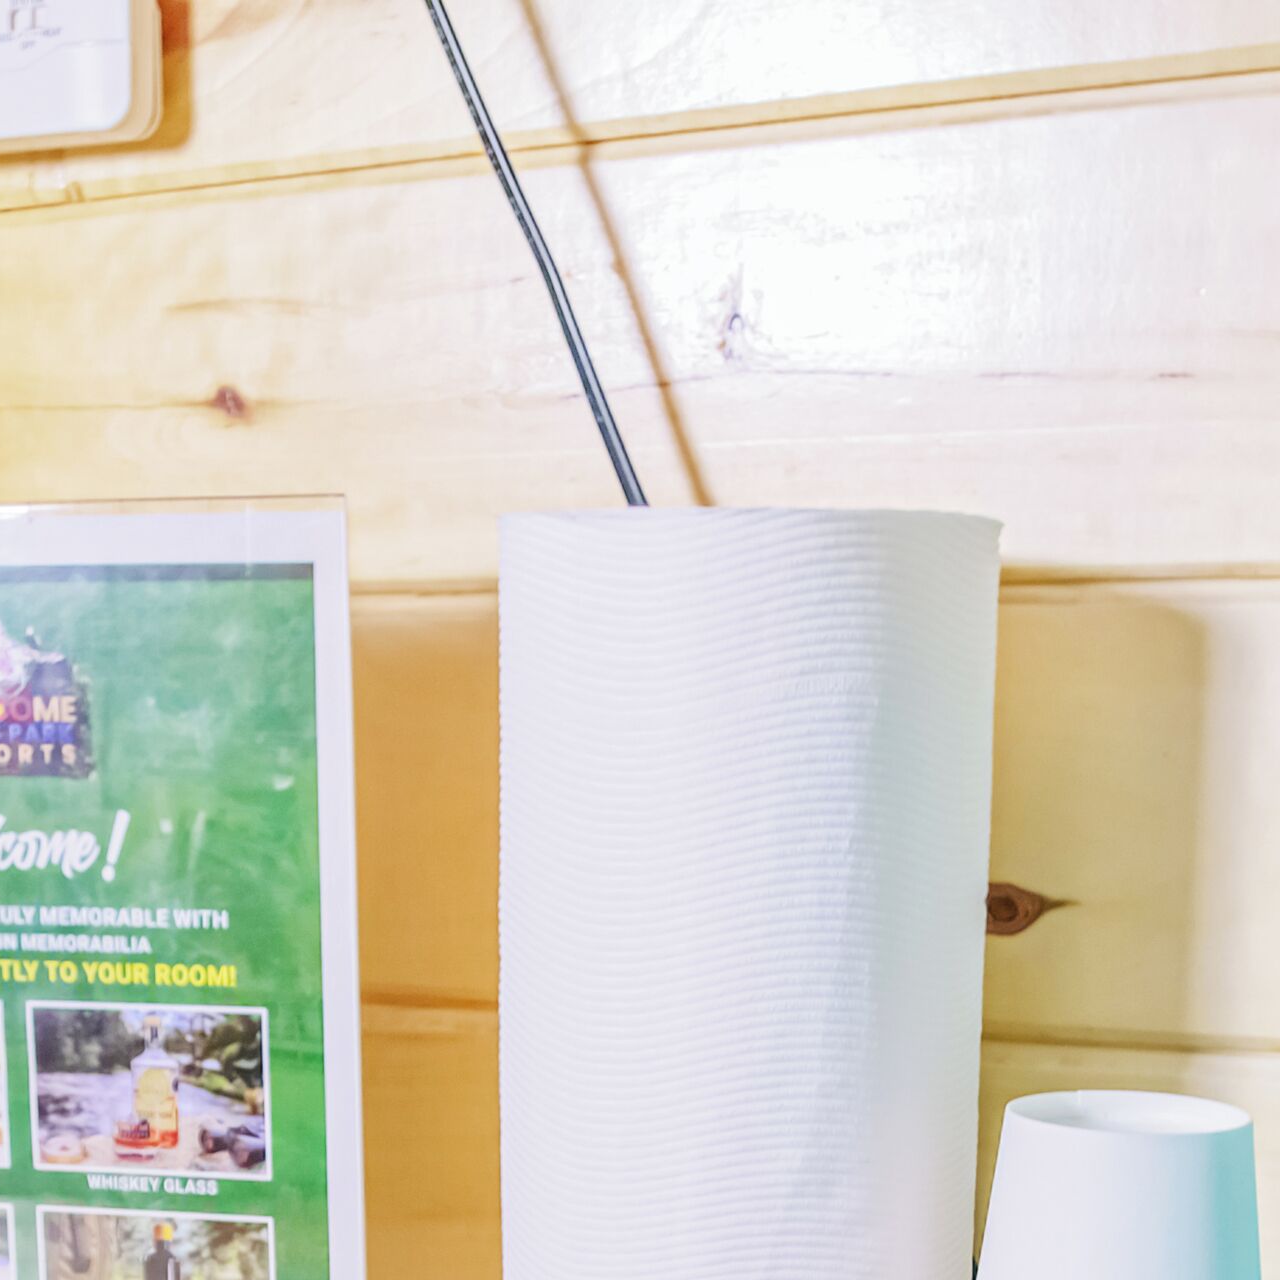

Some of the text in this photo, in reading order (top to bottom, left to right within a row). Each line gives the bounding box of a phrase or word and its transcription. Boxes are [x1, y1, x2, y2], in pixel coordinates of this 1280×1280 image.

[39, 906, 169, 928] MEMORABLE
[173, 908, 229, 929] WITH
[21, 933, 152, 954] MEMORABILIA
[44, 960, 78, 983] TO
[82, 961, 149, 985] YOUR
[155, 963, 237, 988] ROOM!
[87, 1173, 218, 1196] WHISKEY GLASS
